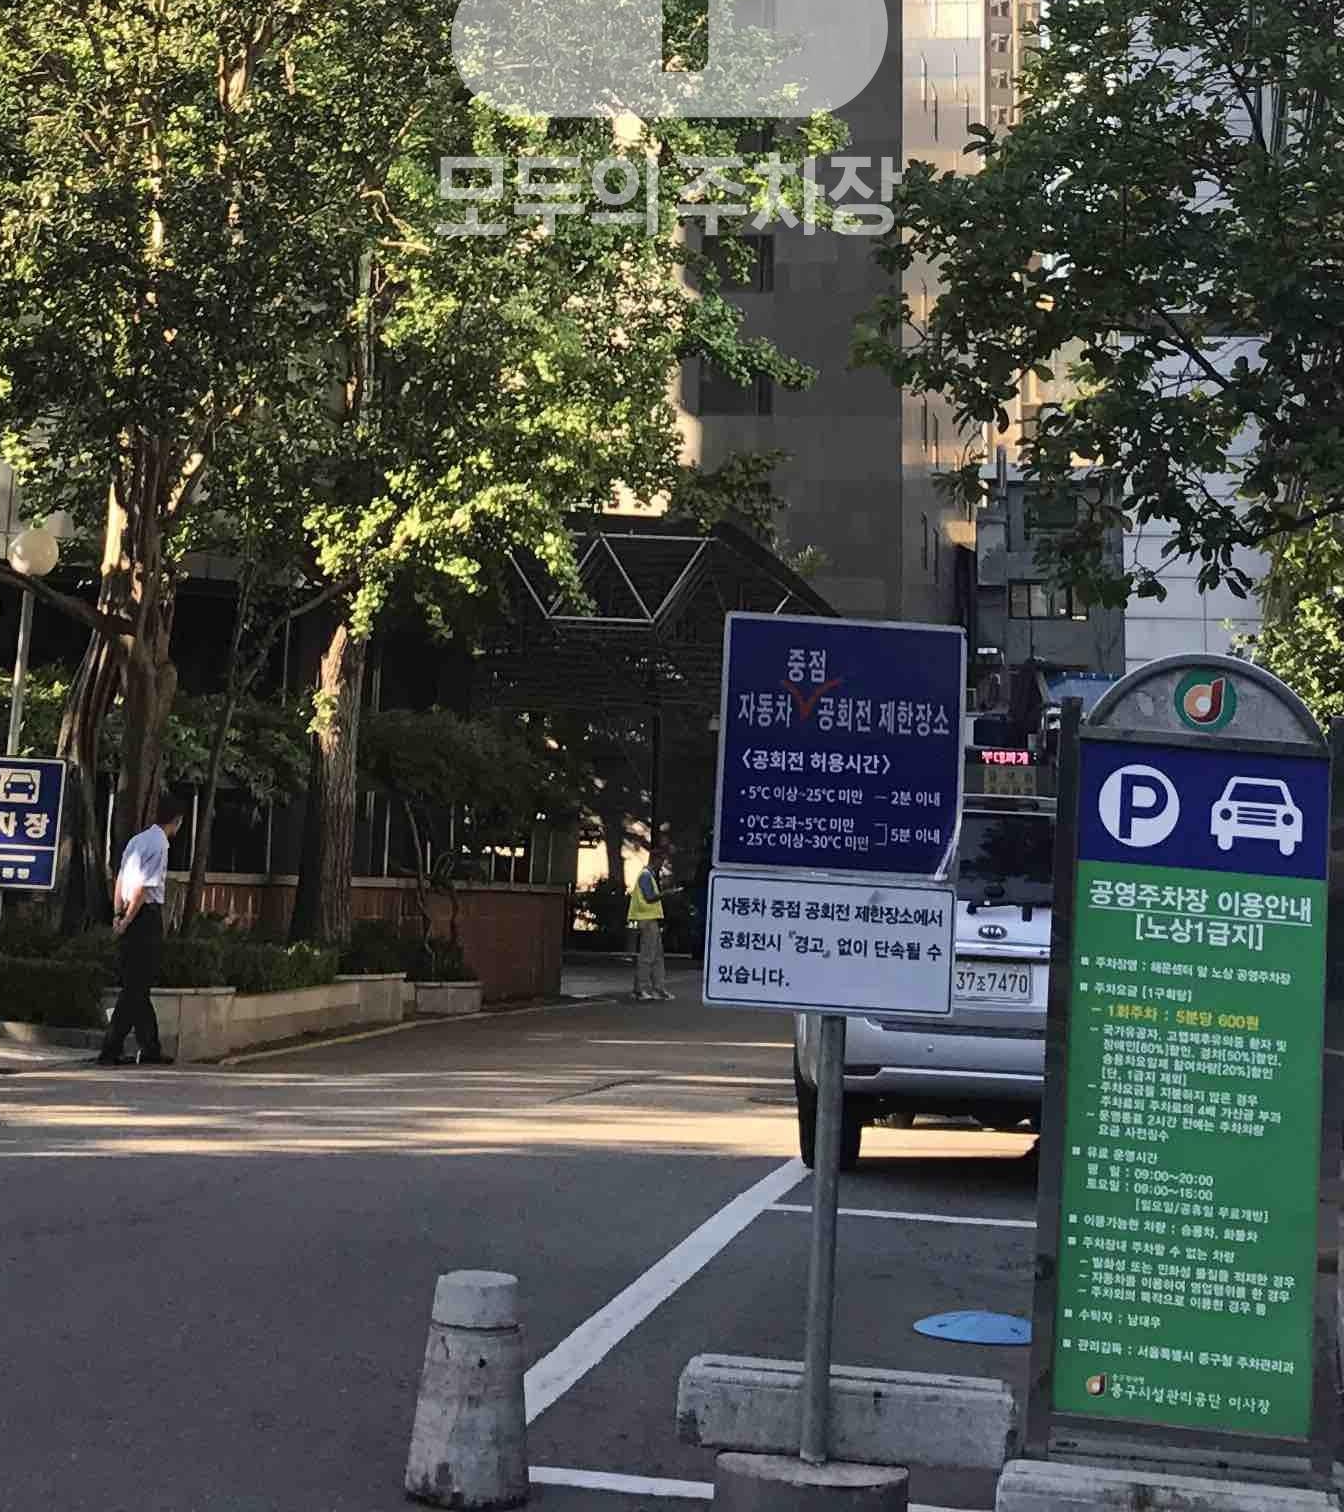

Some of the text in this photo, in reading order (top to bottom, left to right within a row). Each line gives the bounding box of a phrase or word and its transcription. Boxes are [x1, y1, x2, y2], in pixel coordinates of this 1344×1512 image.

[787, 649, 826, 682] 중점
[737, 694, 950, 736] 자동차 공회전 제한장소
[839, 789, 863, 805] 미만
[891, 791, 910, 806] 2분
[915, 791, 940, 807] 이내
[1118, 773, 1169, 840] P
[830, 817, 854, 833] 미만
[845, 835, 869, 852] 미만
[891, 828, 910, 844] 5분
[915, 829, 940, 845] 이내
[721, 896, 943, 927] 자동차 중점 공회전 제한장소에서
[1089, 879, 1311, 922] 공영주차장 이용안내
[720, 931, 782, 952] 공회전시
[838, 937, 868, 958] 없이
[875, 938, 920, 961] 단속될
[927, 943, 942, 961] 수
[718, 965, 790, 987] 있습니다.
[956, 971, 1028, 994] 37조7470
[1094, 982, 1138, 997] 주차요금
[1237, 968, 1291, 985] 공영주차장
[1110, 1382, 1270, 1414] 중구시설관리공단 이사장
